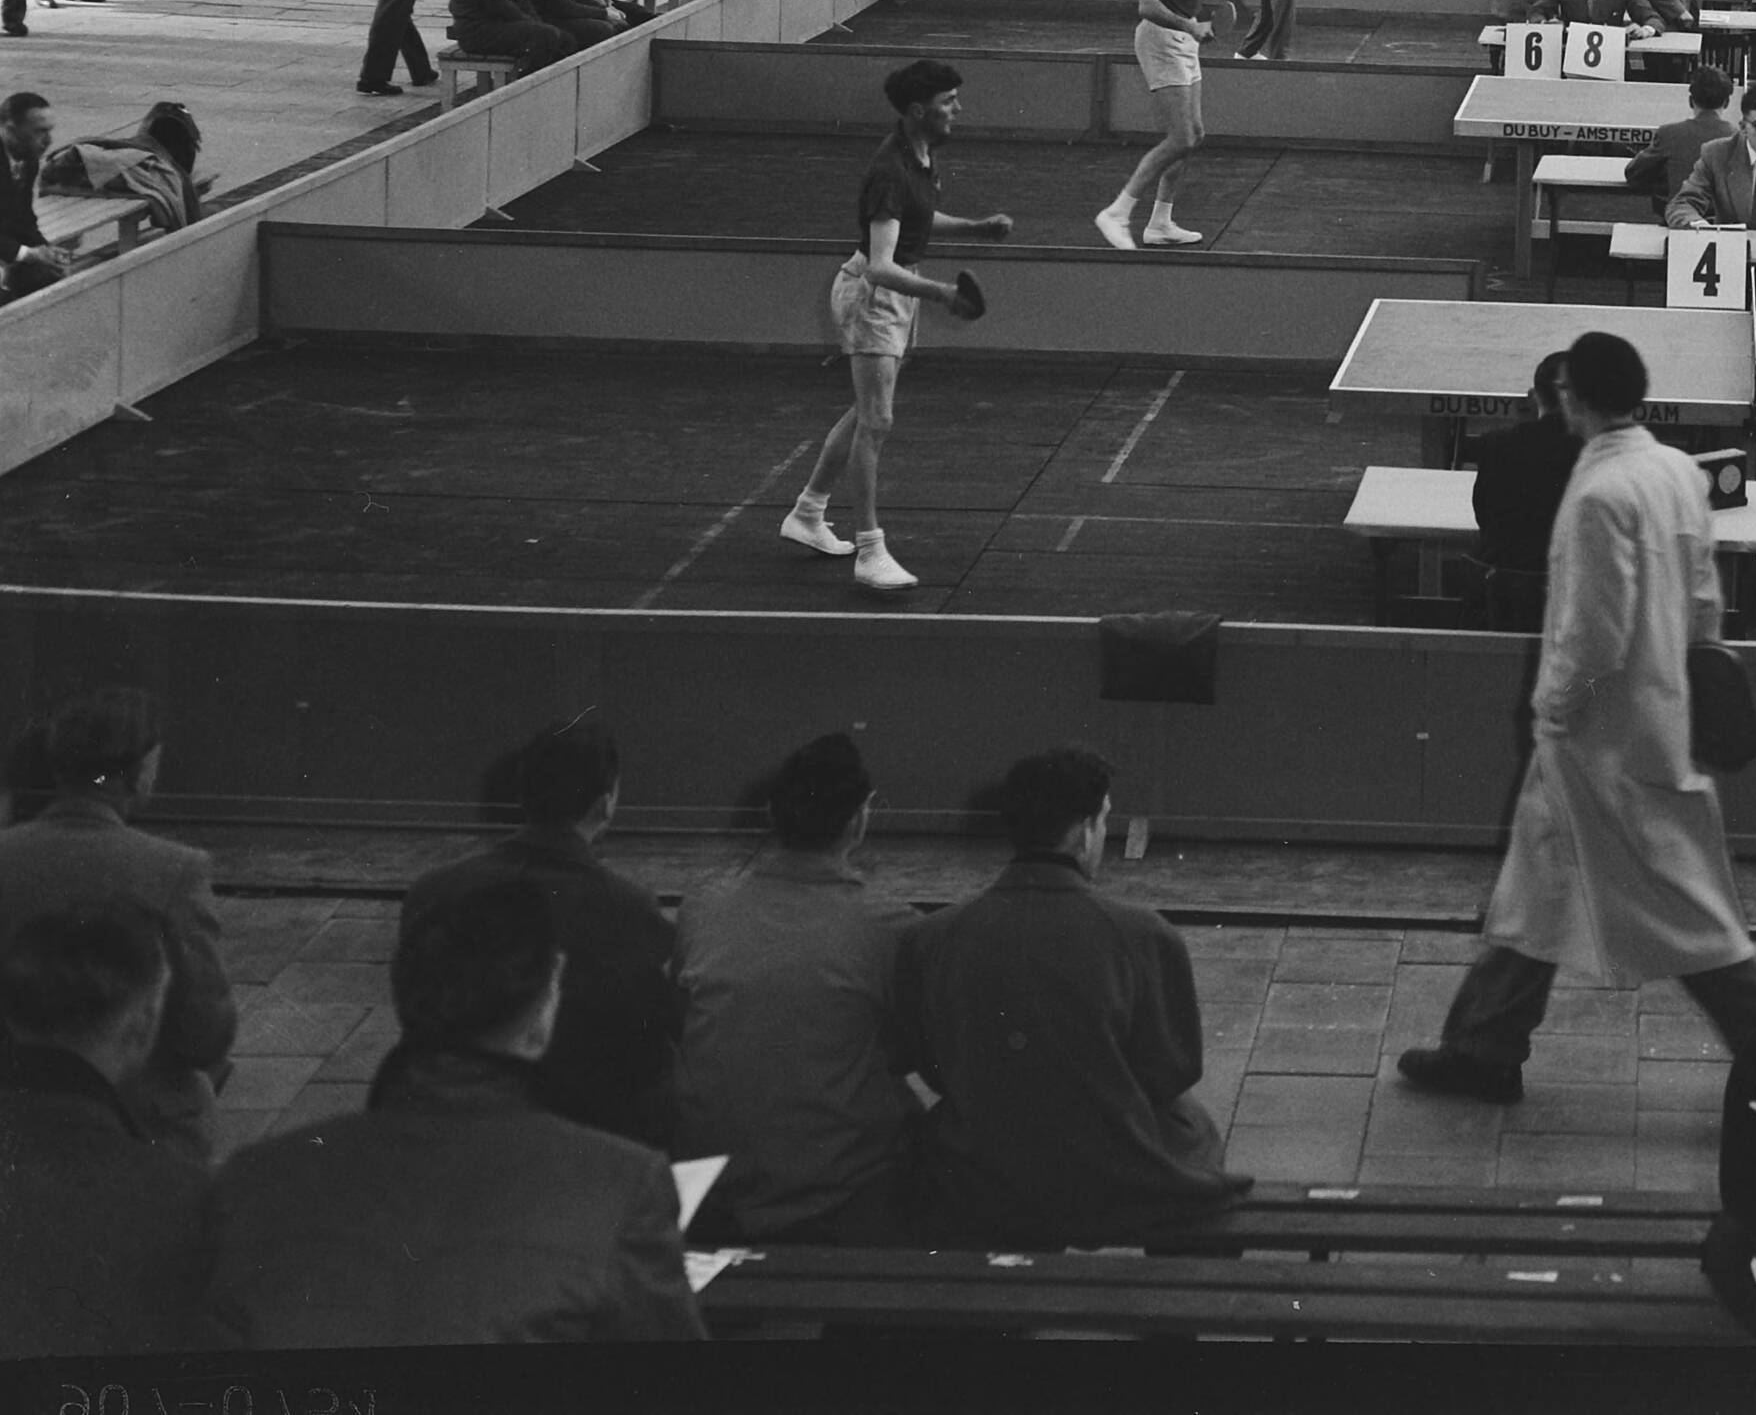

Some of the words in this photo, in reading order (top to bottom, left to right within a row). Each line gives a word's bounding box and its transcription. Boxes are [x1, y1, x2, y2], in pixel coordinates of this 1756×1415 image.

[1525, 32, 1543, 71] 6
[1583, 31, 1604, 67] 8
[1576, 126, 1658, 142] AMSTERD
[1693, 242, 1720, 296] 4
